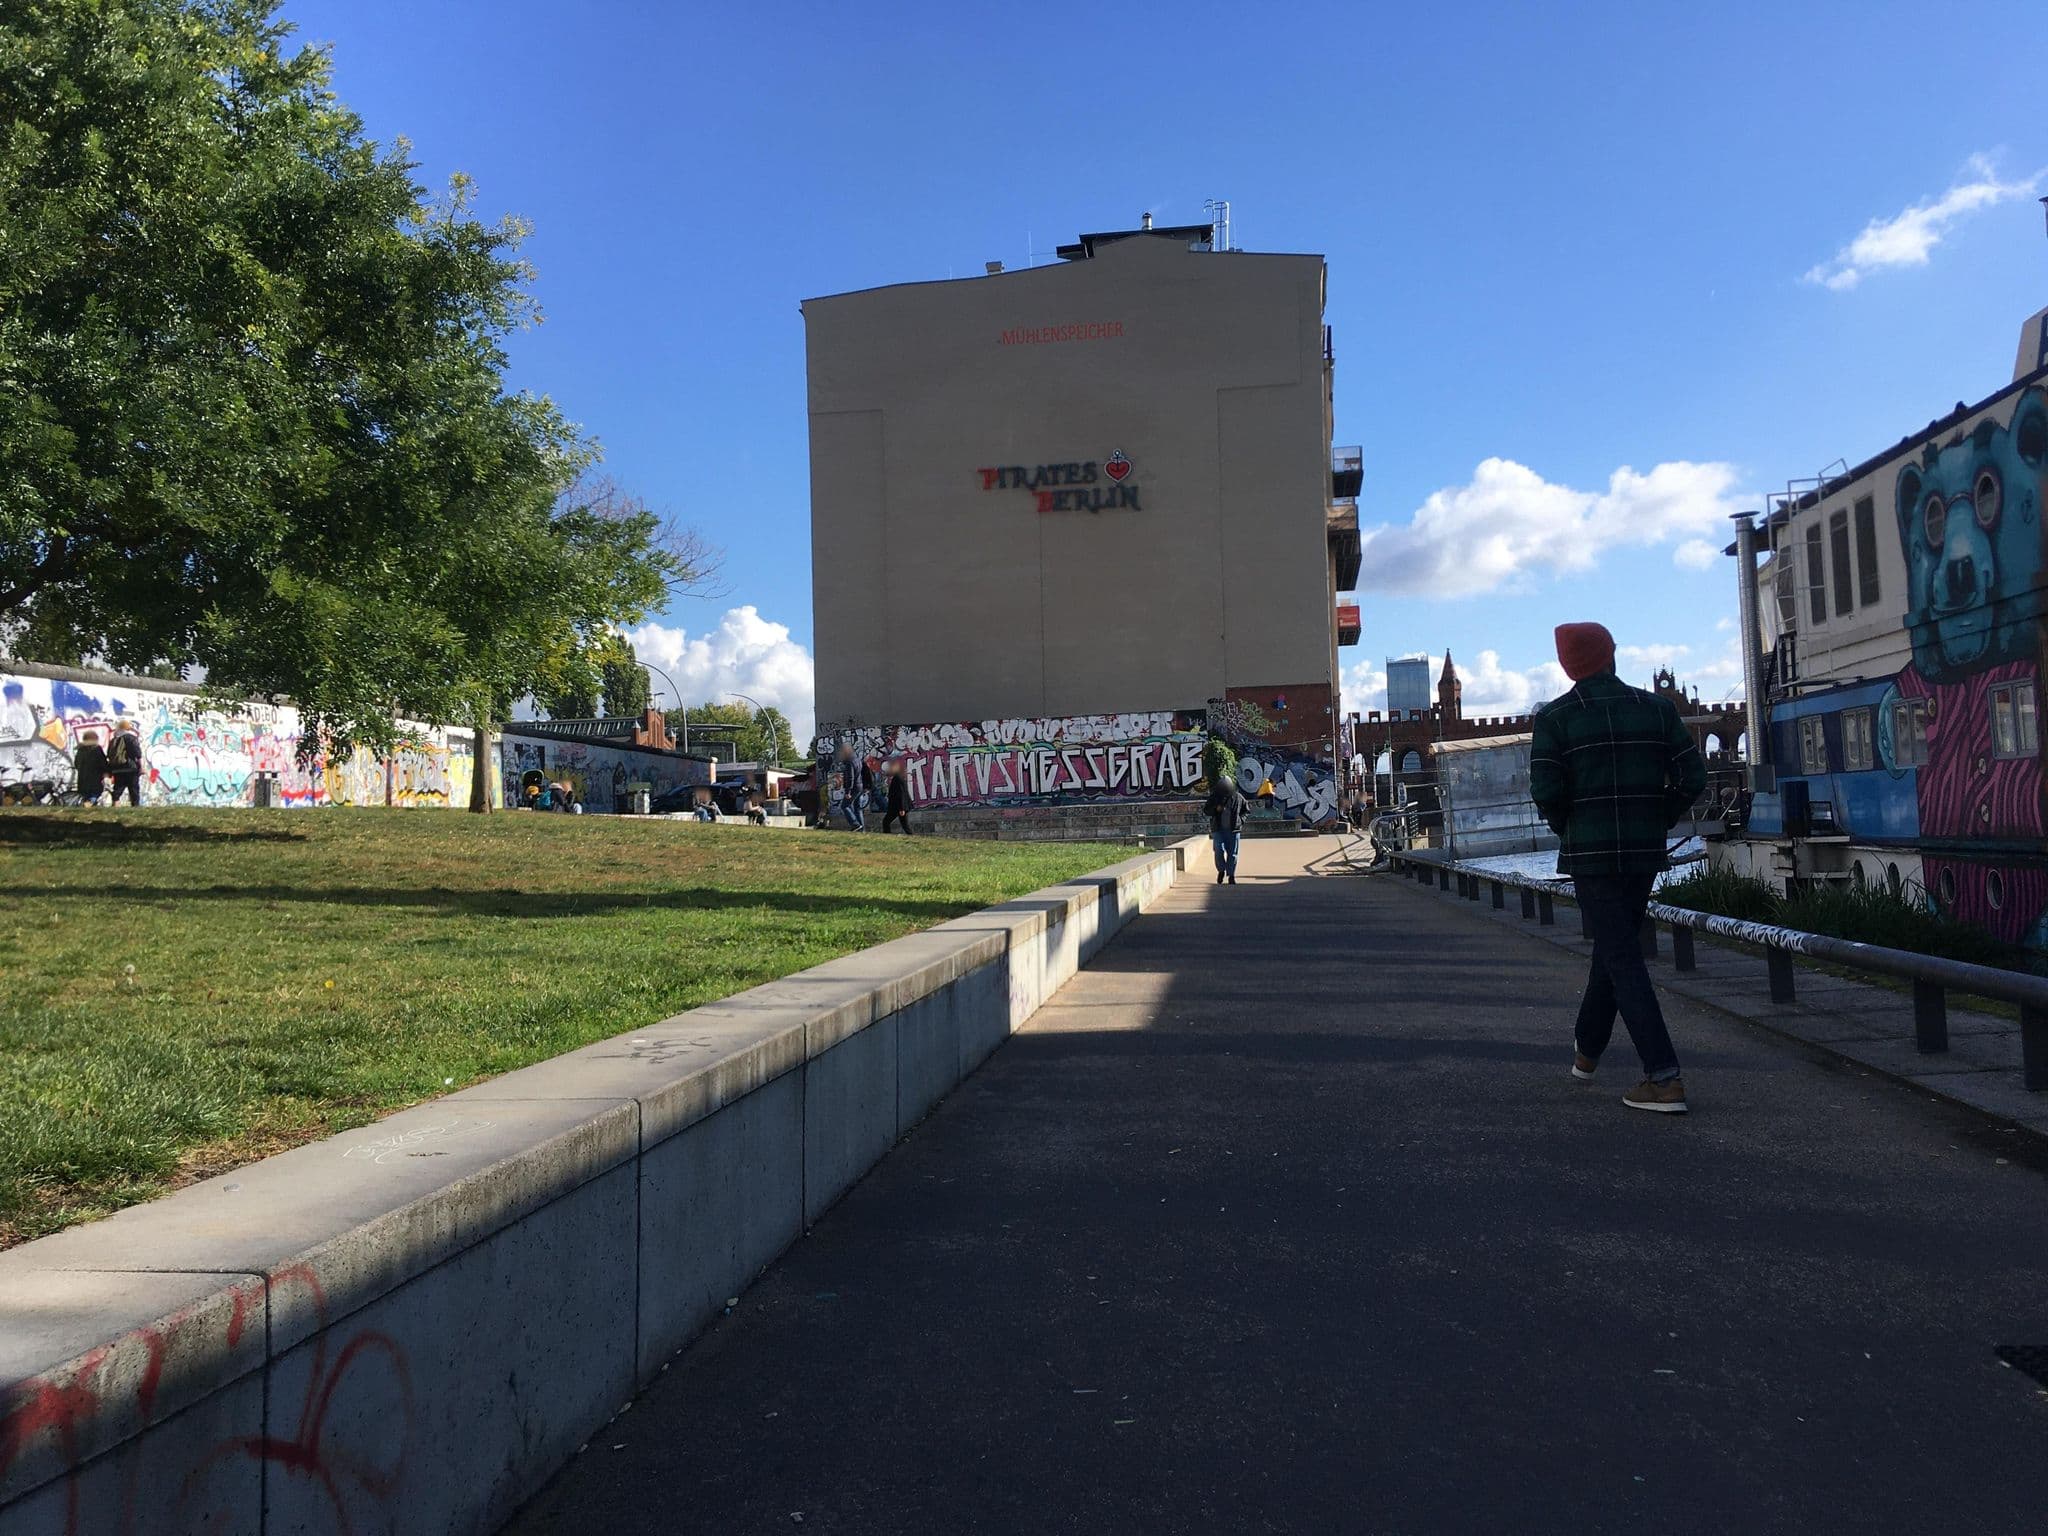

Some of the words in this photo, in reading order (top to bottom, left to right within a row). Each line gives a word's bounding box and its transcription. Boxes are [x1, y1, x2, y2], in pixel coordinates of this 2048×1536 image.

[1001, 321, 1124, 346] MÜHLENSPEICHER
[974, 461, 1099, 491] PIRATES
[1031, 482, 1142, 514] BERLIN
